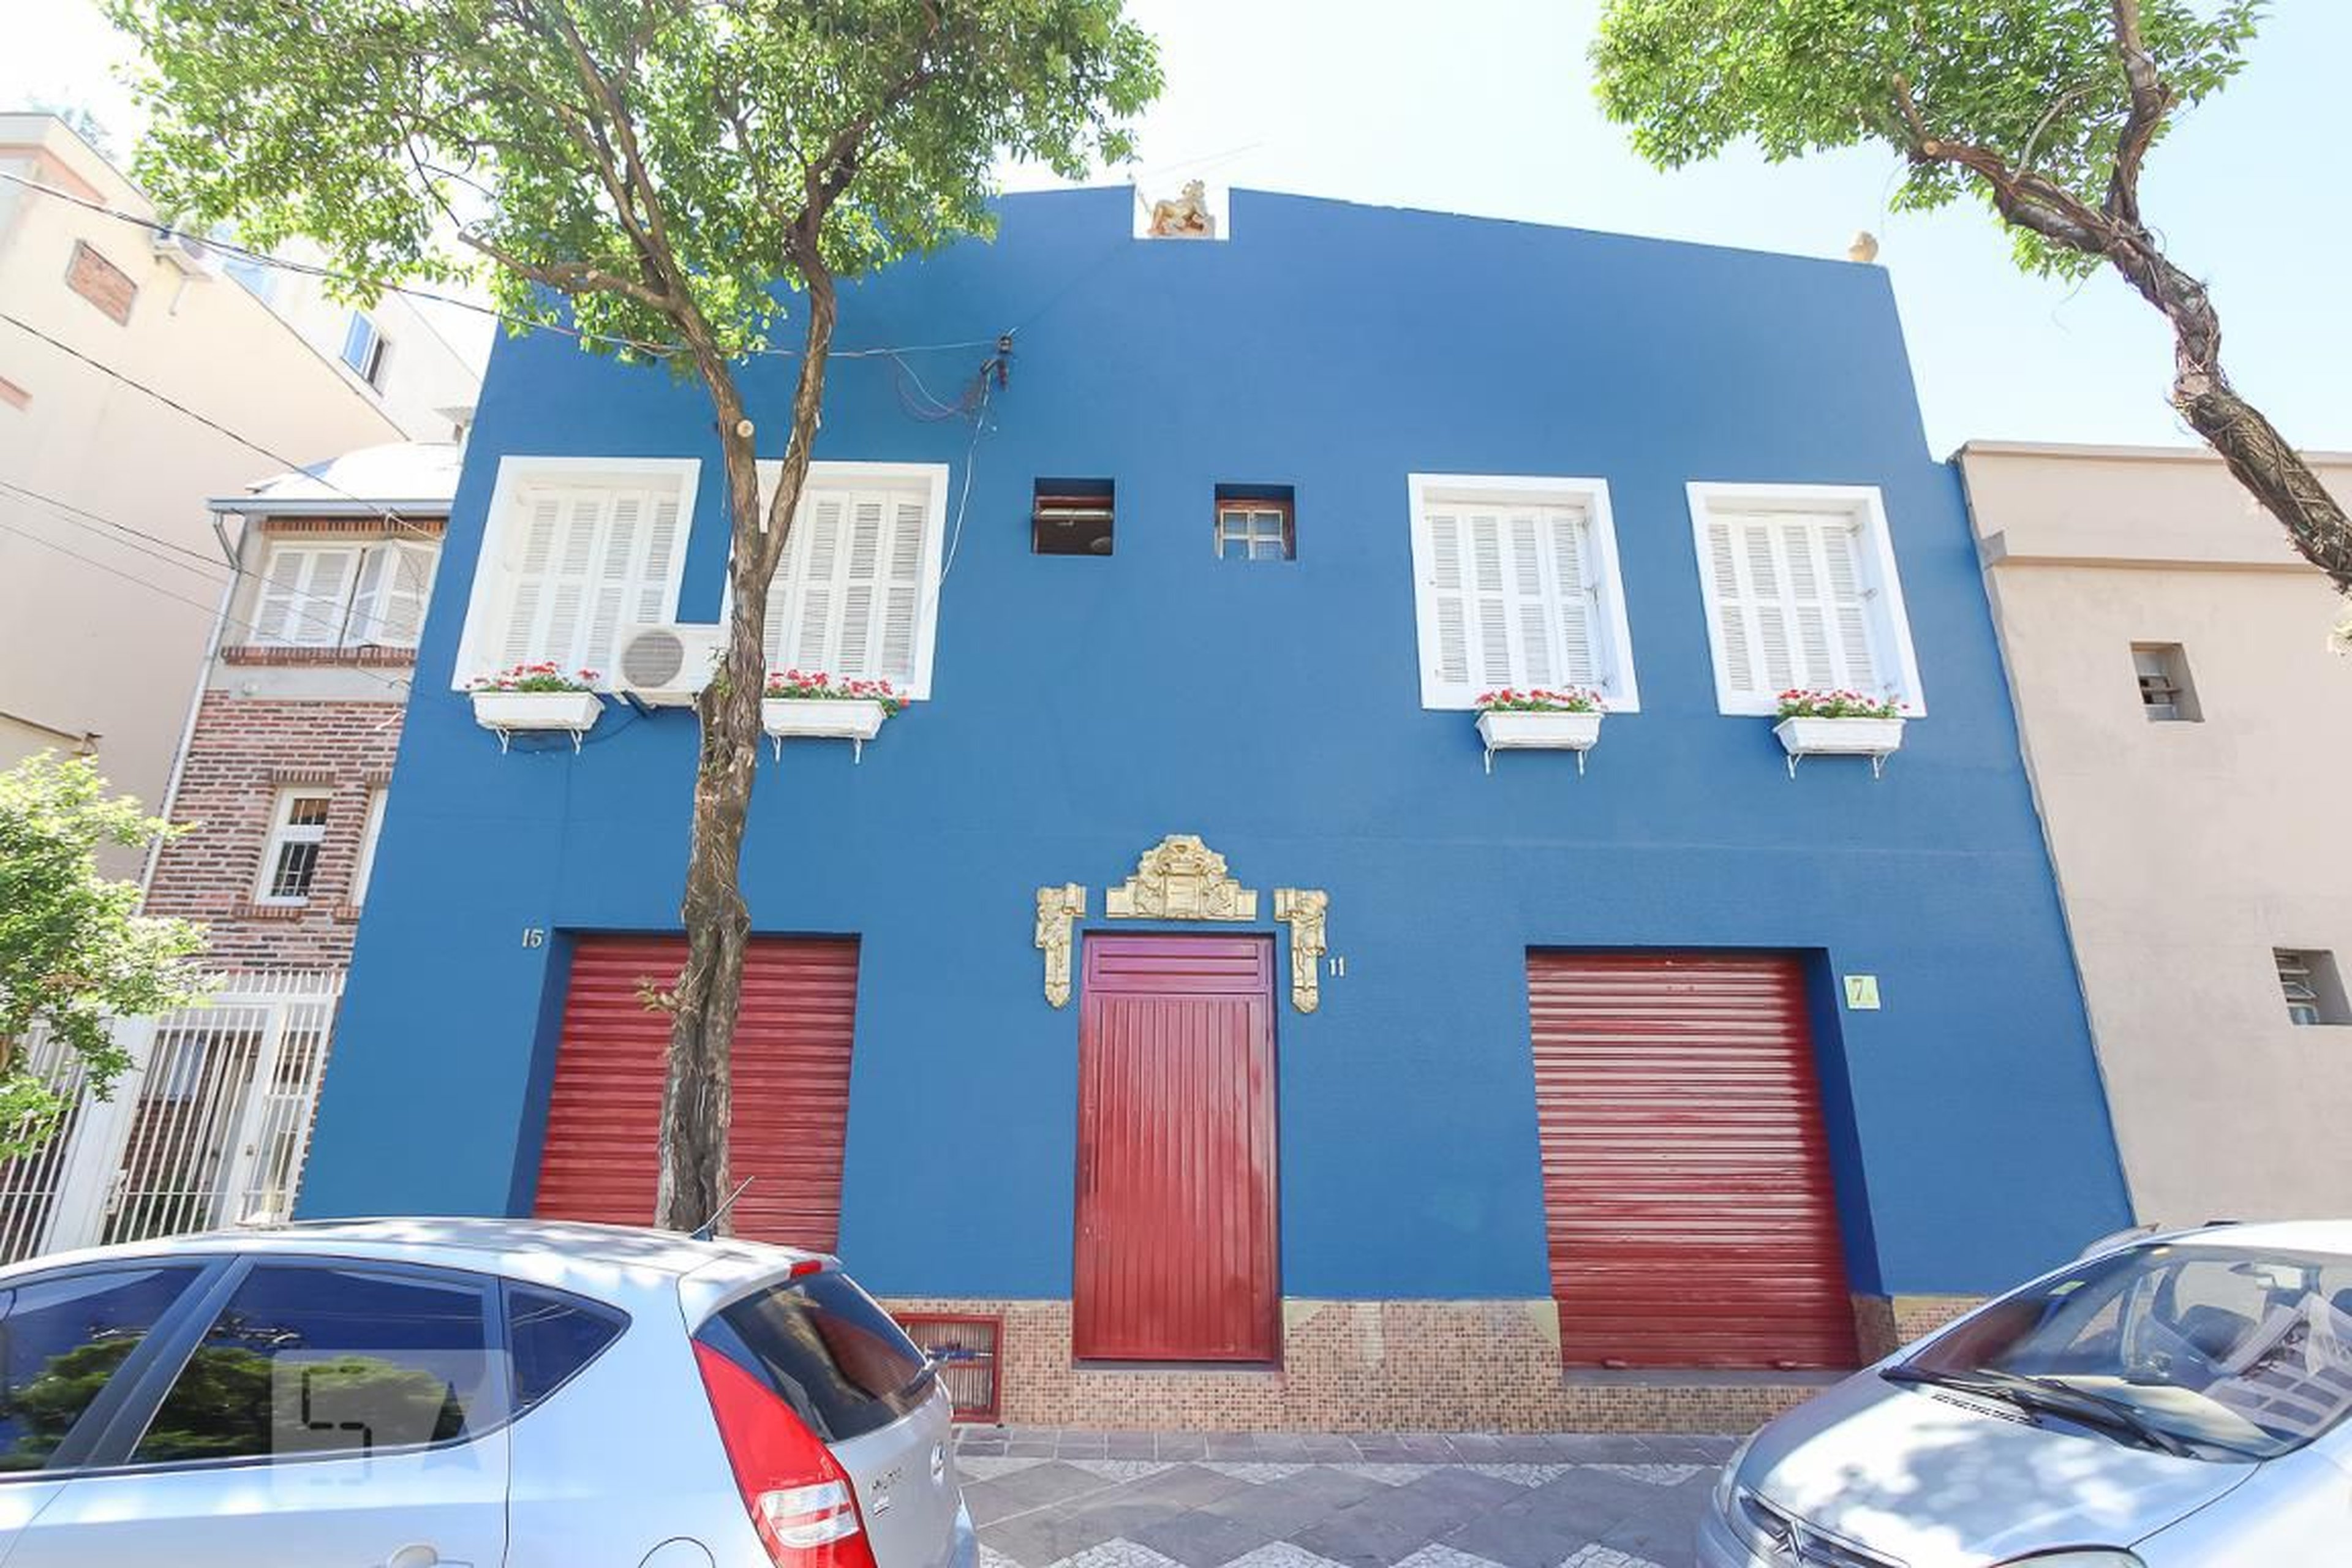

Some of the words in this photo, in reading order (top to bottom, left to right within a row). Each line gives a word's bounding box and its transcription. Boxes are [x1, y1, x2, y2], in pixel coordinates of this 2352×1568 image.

[522, 928, 544, 948] 15
[1329, 957, 1344, 976] 11
[1852, 978, 1863, 1001] 7
